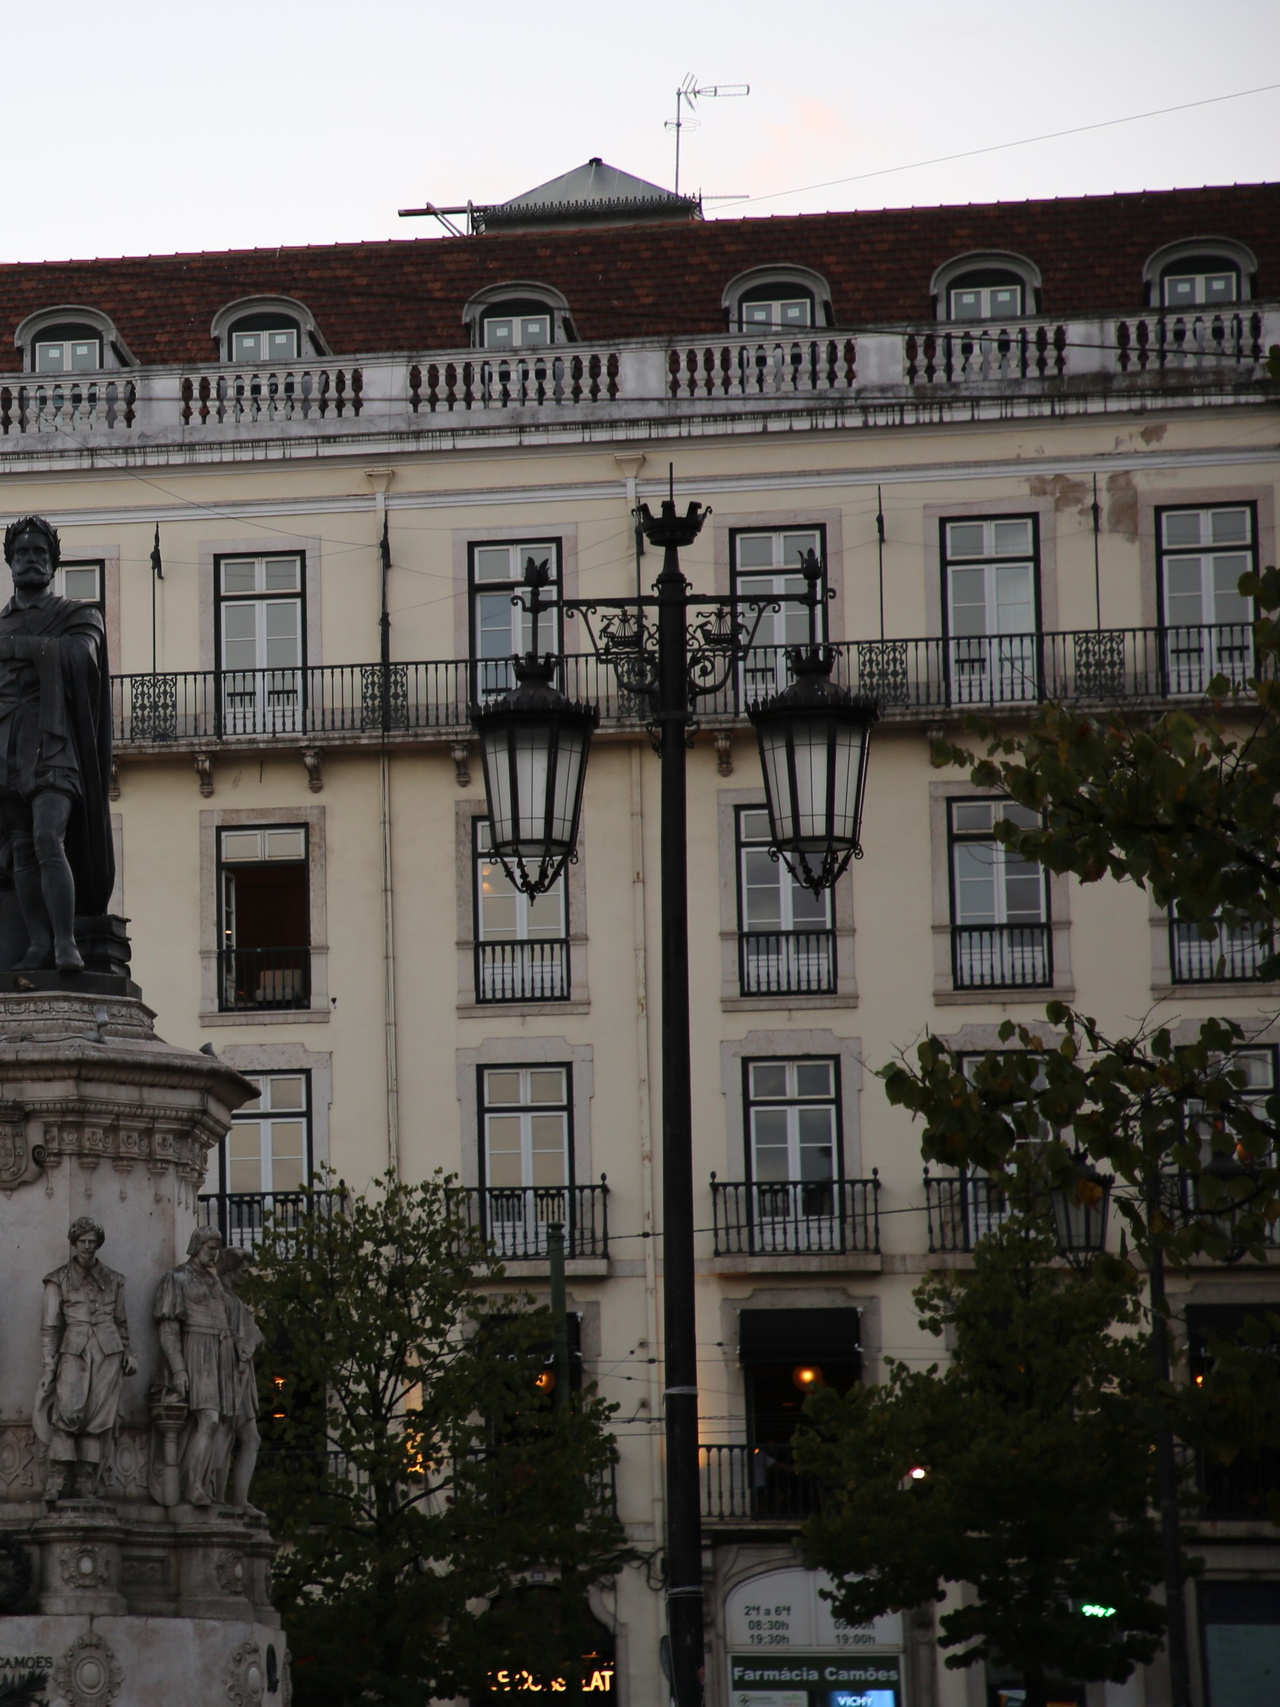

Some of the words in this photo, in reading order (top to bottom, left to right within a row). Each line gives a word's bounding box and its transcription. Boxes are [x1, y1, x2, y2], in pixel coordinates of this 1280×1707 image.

[748, 1619, 789, 1631] 08:30h
[749, 1633, 790, 1645] 19:30h
[733, 1666, 819, 1681] Farmácia
[824, 1666, 899, 1681] Camões
[837, 1695, 874, 1707] VICHY
